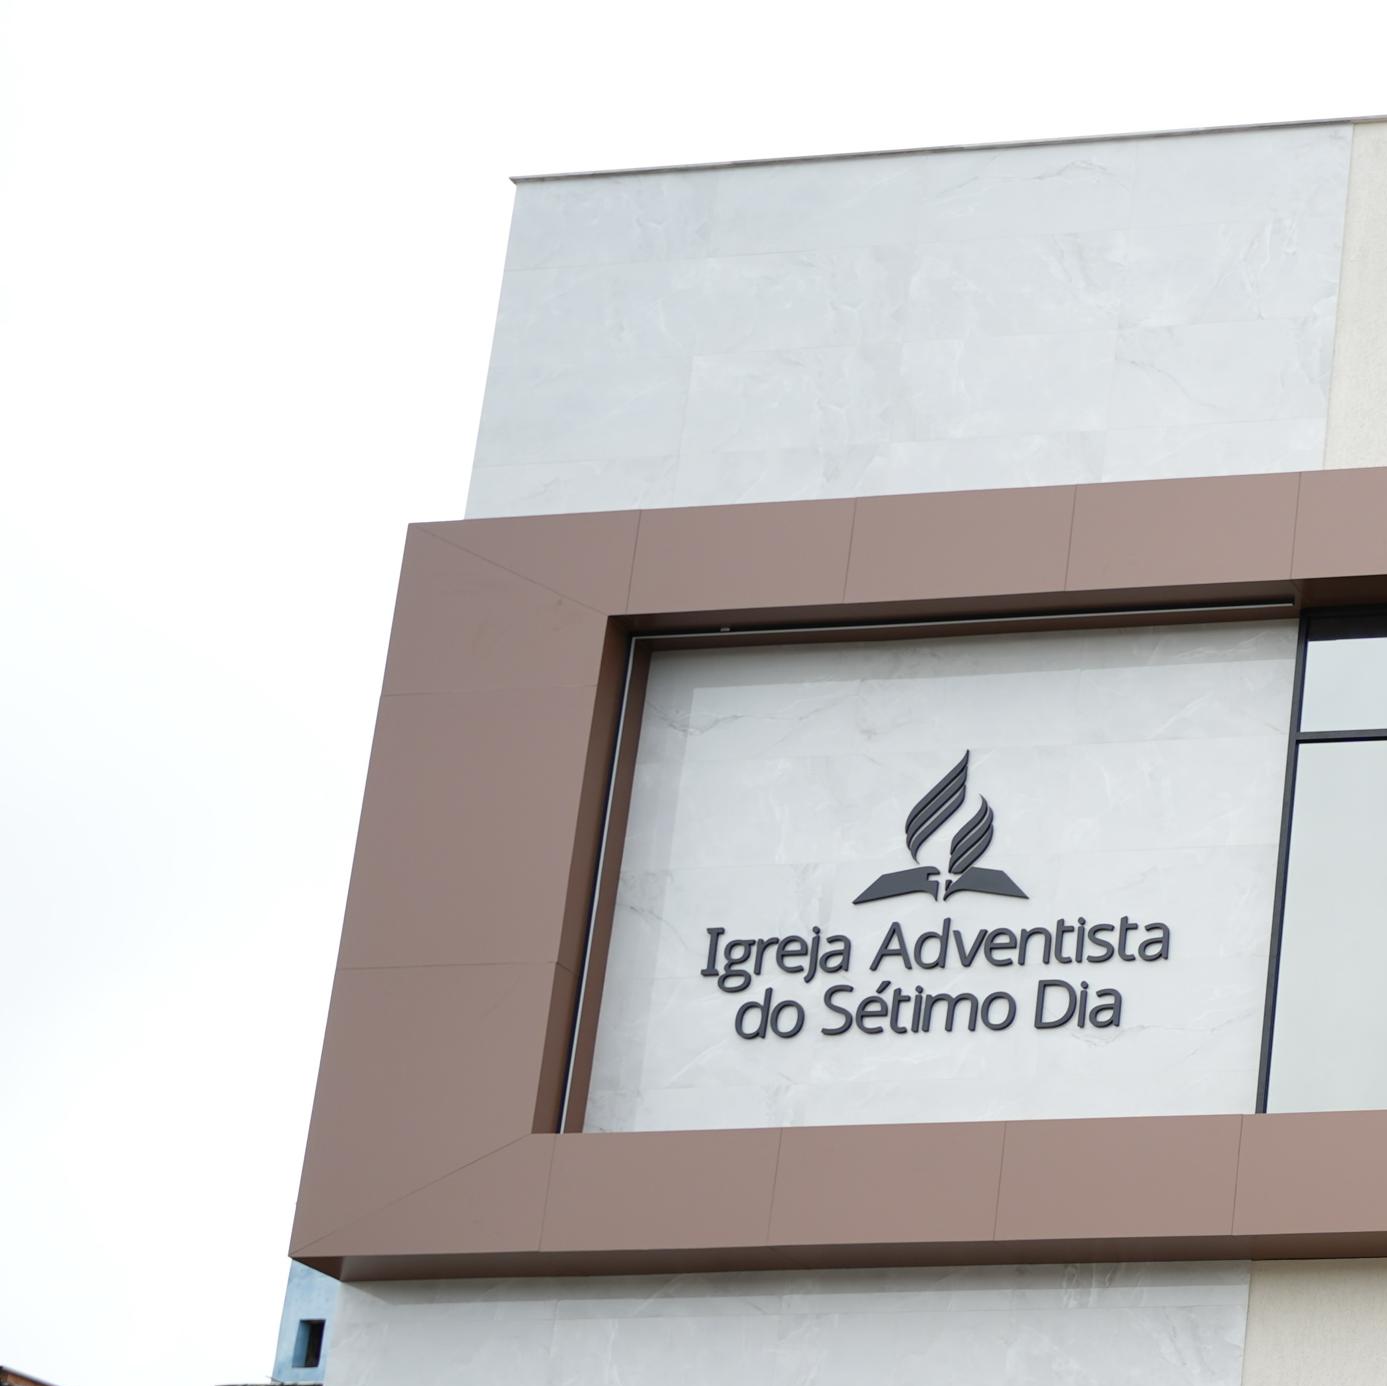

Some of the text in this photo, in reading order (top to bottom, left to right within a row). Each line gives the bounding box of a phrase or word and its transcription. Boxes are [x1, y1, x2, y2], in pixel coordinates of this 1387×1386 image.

[700, 915, 1171, 995] Igreja Adventista
[734, 979, 1123, 1041] do Sétimo Dia
